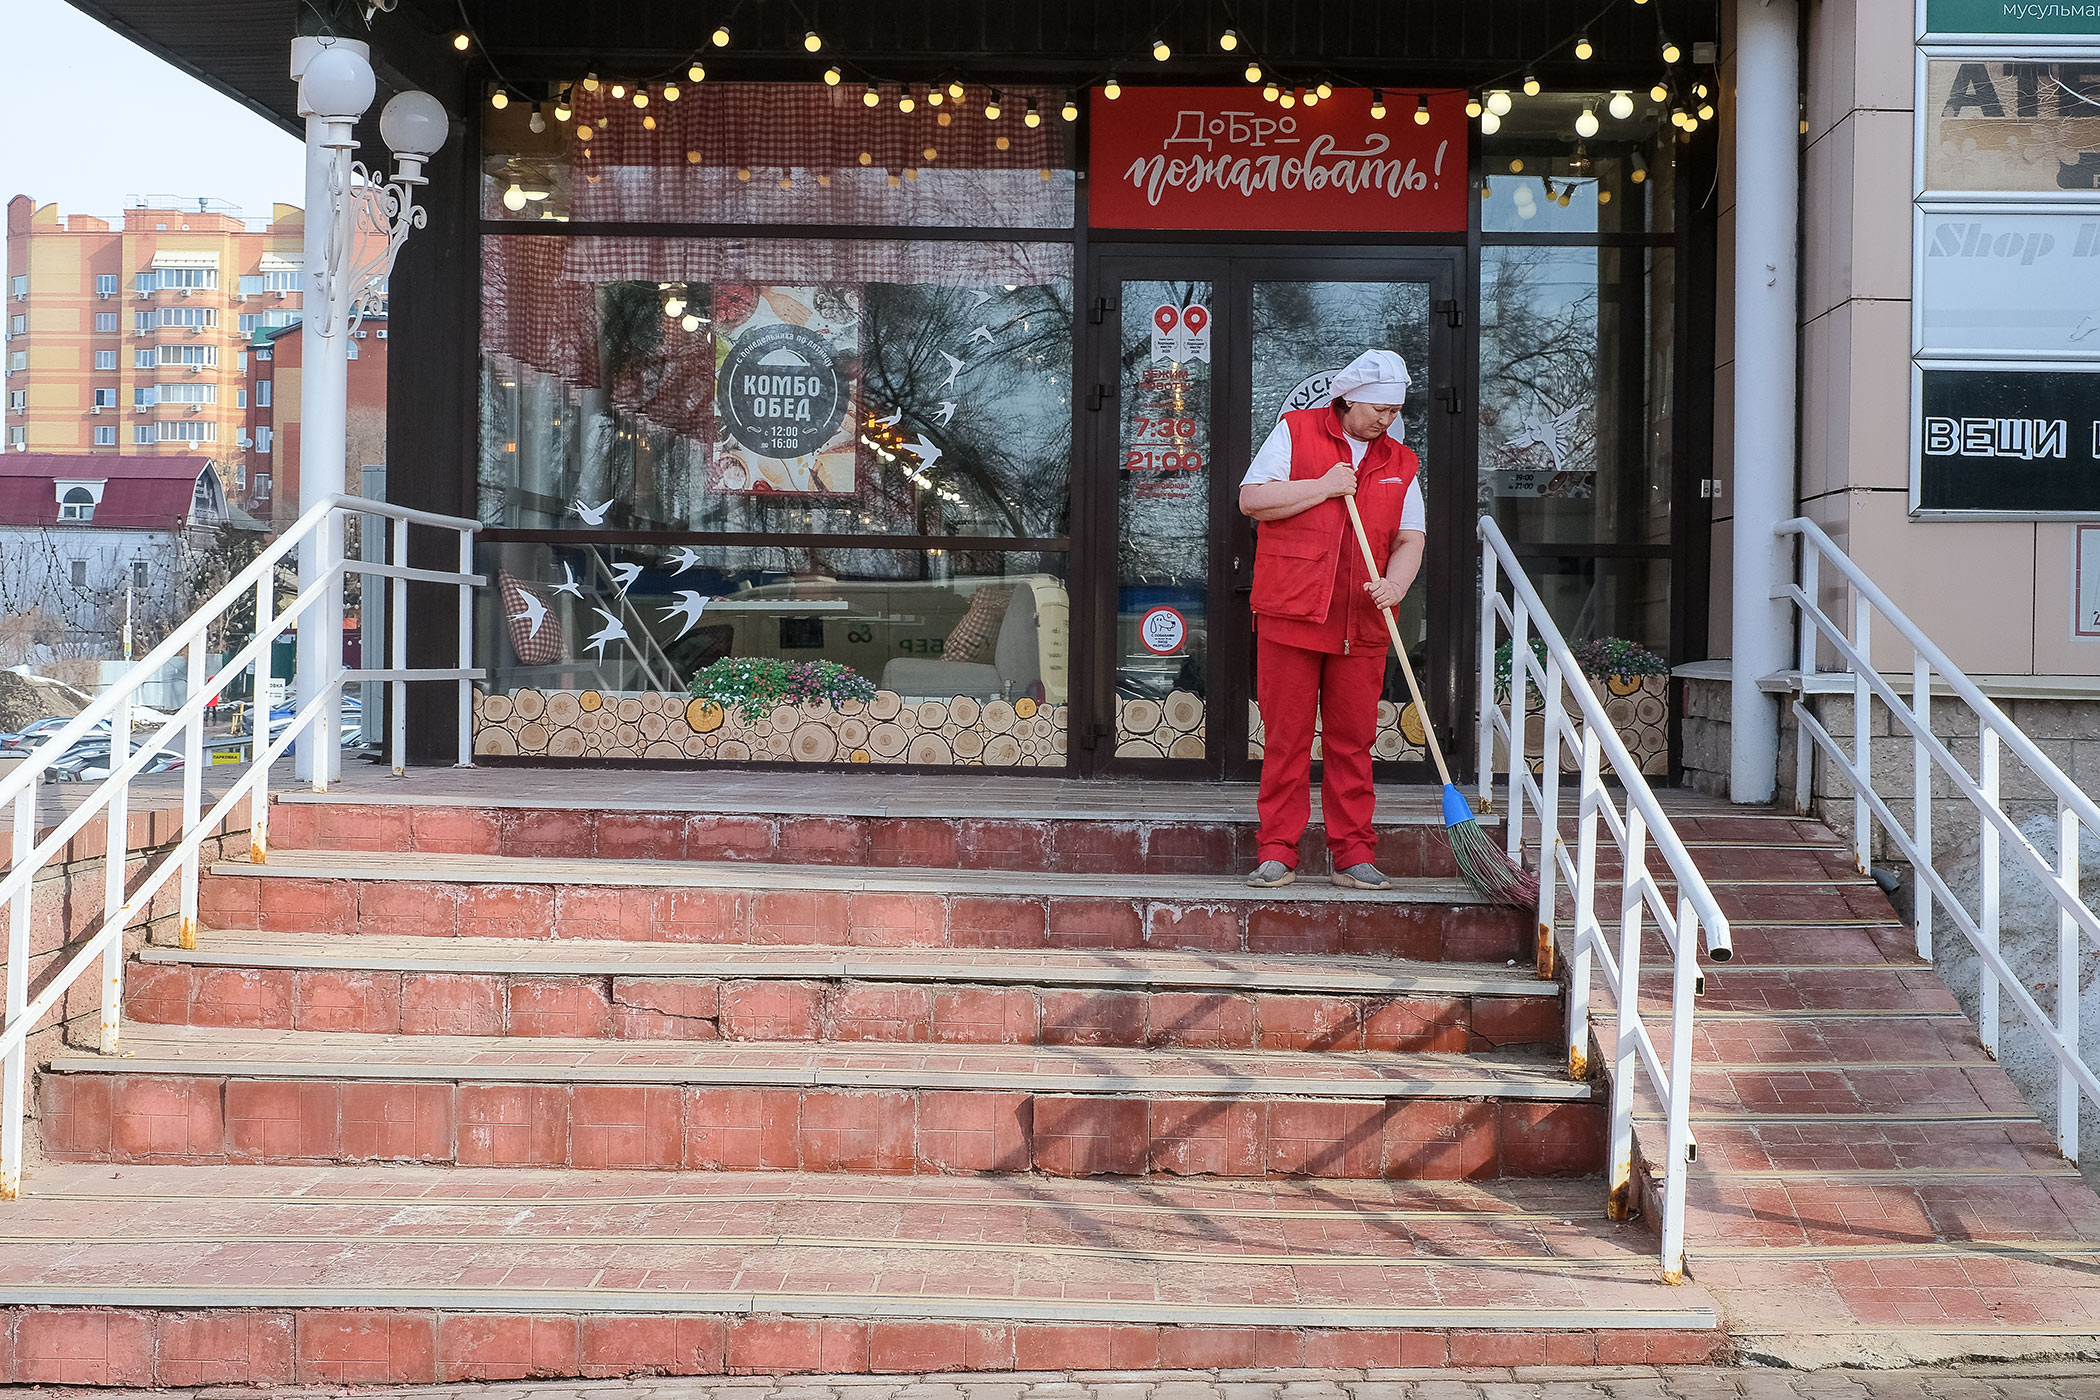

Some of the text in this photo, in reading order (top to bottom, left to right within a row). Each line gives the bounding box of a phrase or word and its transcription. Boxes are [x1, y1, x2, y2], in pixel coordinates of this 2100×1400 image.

[2003, 3, 2100, 20] мусульма
[1123, 133, 1449, 206] пожаловать!
[1928, 222, 2056, 266] Shop
[741, 333, 794, 359] понедельника
[806, 339, 834, 367] пятницу
[1142, 369, 1189, 380] РЕЖИМ
[743, 375, 821, 397] КОМБО
[753, 398, 811, 422] ОБЕД
[771, 426, 798, 437] 12:00
[1133, 417, 1196, 438] 7:30
[771, 438, 798, 449] 16:00
[1924, 416, 2068, 461] ВЕЩИ
[1126, 451, 1203, 472] 21:00
